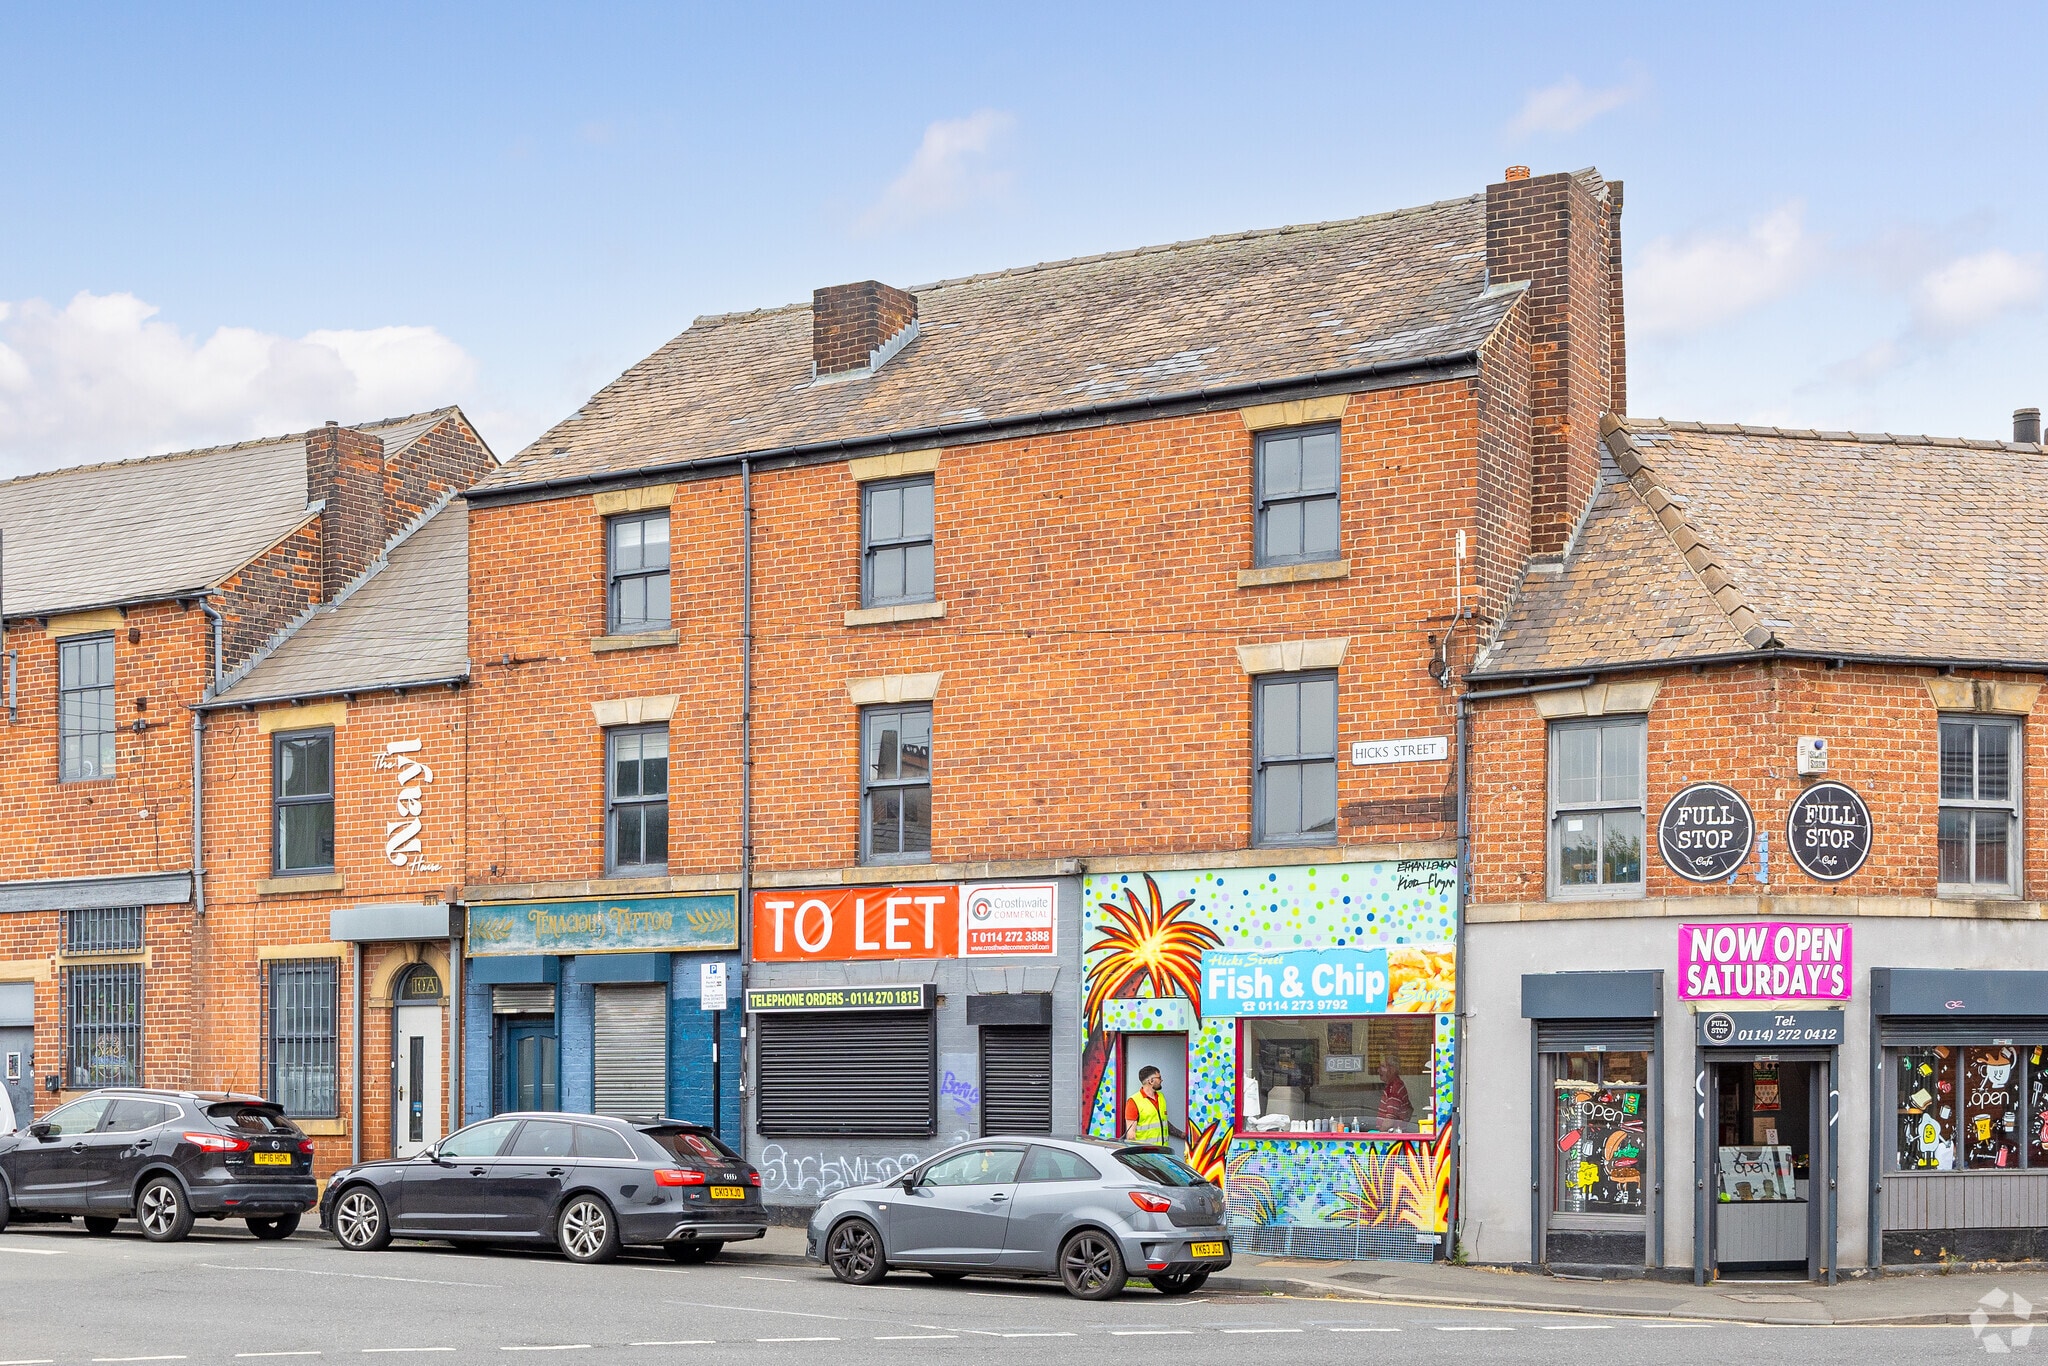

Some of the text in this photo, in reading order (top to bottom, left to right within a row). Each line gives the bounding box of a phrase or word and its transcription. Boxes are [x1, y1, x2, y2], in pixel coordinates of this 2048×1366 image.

[1355, 746, 1389, 759] HICKS
[1393, 743, 1437, 757] STREET
[372, 752, 396, 772] The
[385, 737, 433, 866] Nayl
[1678, 805, 1735, 825] FULL
[1804, 804, 1856, 825] FULL
[1678, 830, 1733, 849] STOP
[1805, 829, 1855, 849] STOP
[409, 853, 442, 876] House
[1695, 856, 1714, 867] Cafe
[1821, 855, 1838, 866] Cafe
[993, 896, 1048, 909] Crosthwaite
[528, 906, 673, 940] TENACIOUS TATTOO
[993, 910, 1047, 919] COMMERCIAL
[764, 895, 946, 953] TO LET
[971, 930, 1050, 943] T 0114 272 3888
[1690, 926, 1844, 963] NOW OPEN
[1208, 953, 1284, 968] Hicks Street
[1208, 963, 1385, 1004] Fish & Chip
[1686, 963, 1845, 997] SATURDAY'S
[750, 993, 805, 1007] TELEPHONE
[806, 992, 844, 1006] ORDERS
[850, 991, 874, 1005] 0114
[875, 991, 894, 1004] 270
[895, 990, 919, 1004] 1815
[1393, 979, 1450, 1010] Shop
[1258, 1000, 1348, 1011] 0114 273 9792
[1774, 1015, 1796, 1027] Tel:
[1738, 1028, 1837, 1042] 0114) 272 0412
[1328, 1058, 1361, 1070] OPEN
[1971, 1091, 2010, 1109] open
[1581, 1101, 1624, 1127] open
[259, 1153, 273, 1163] HF16
[714, 1187, 729, 1197] GK13
